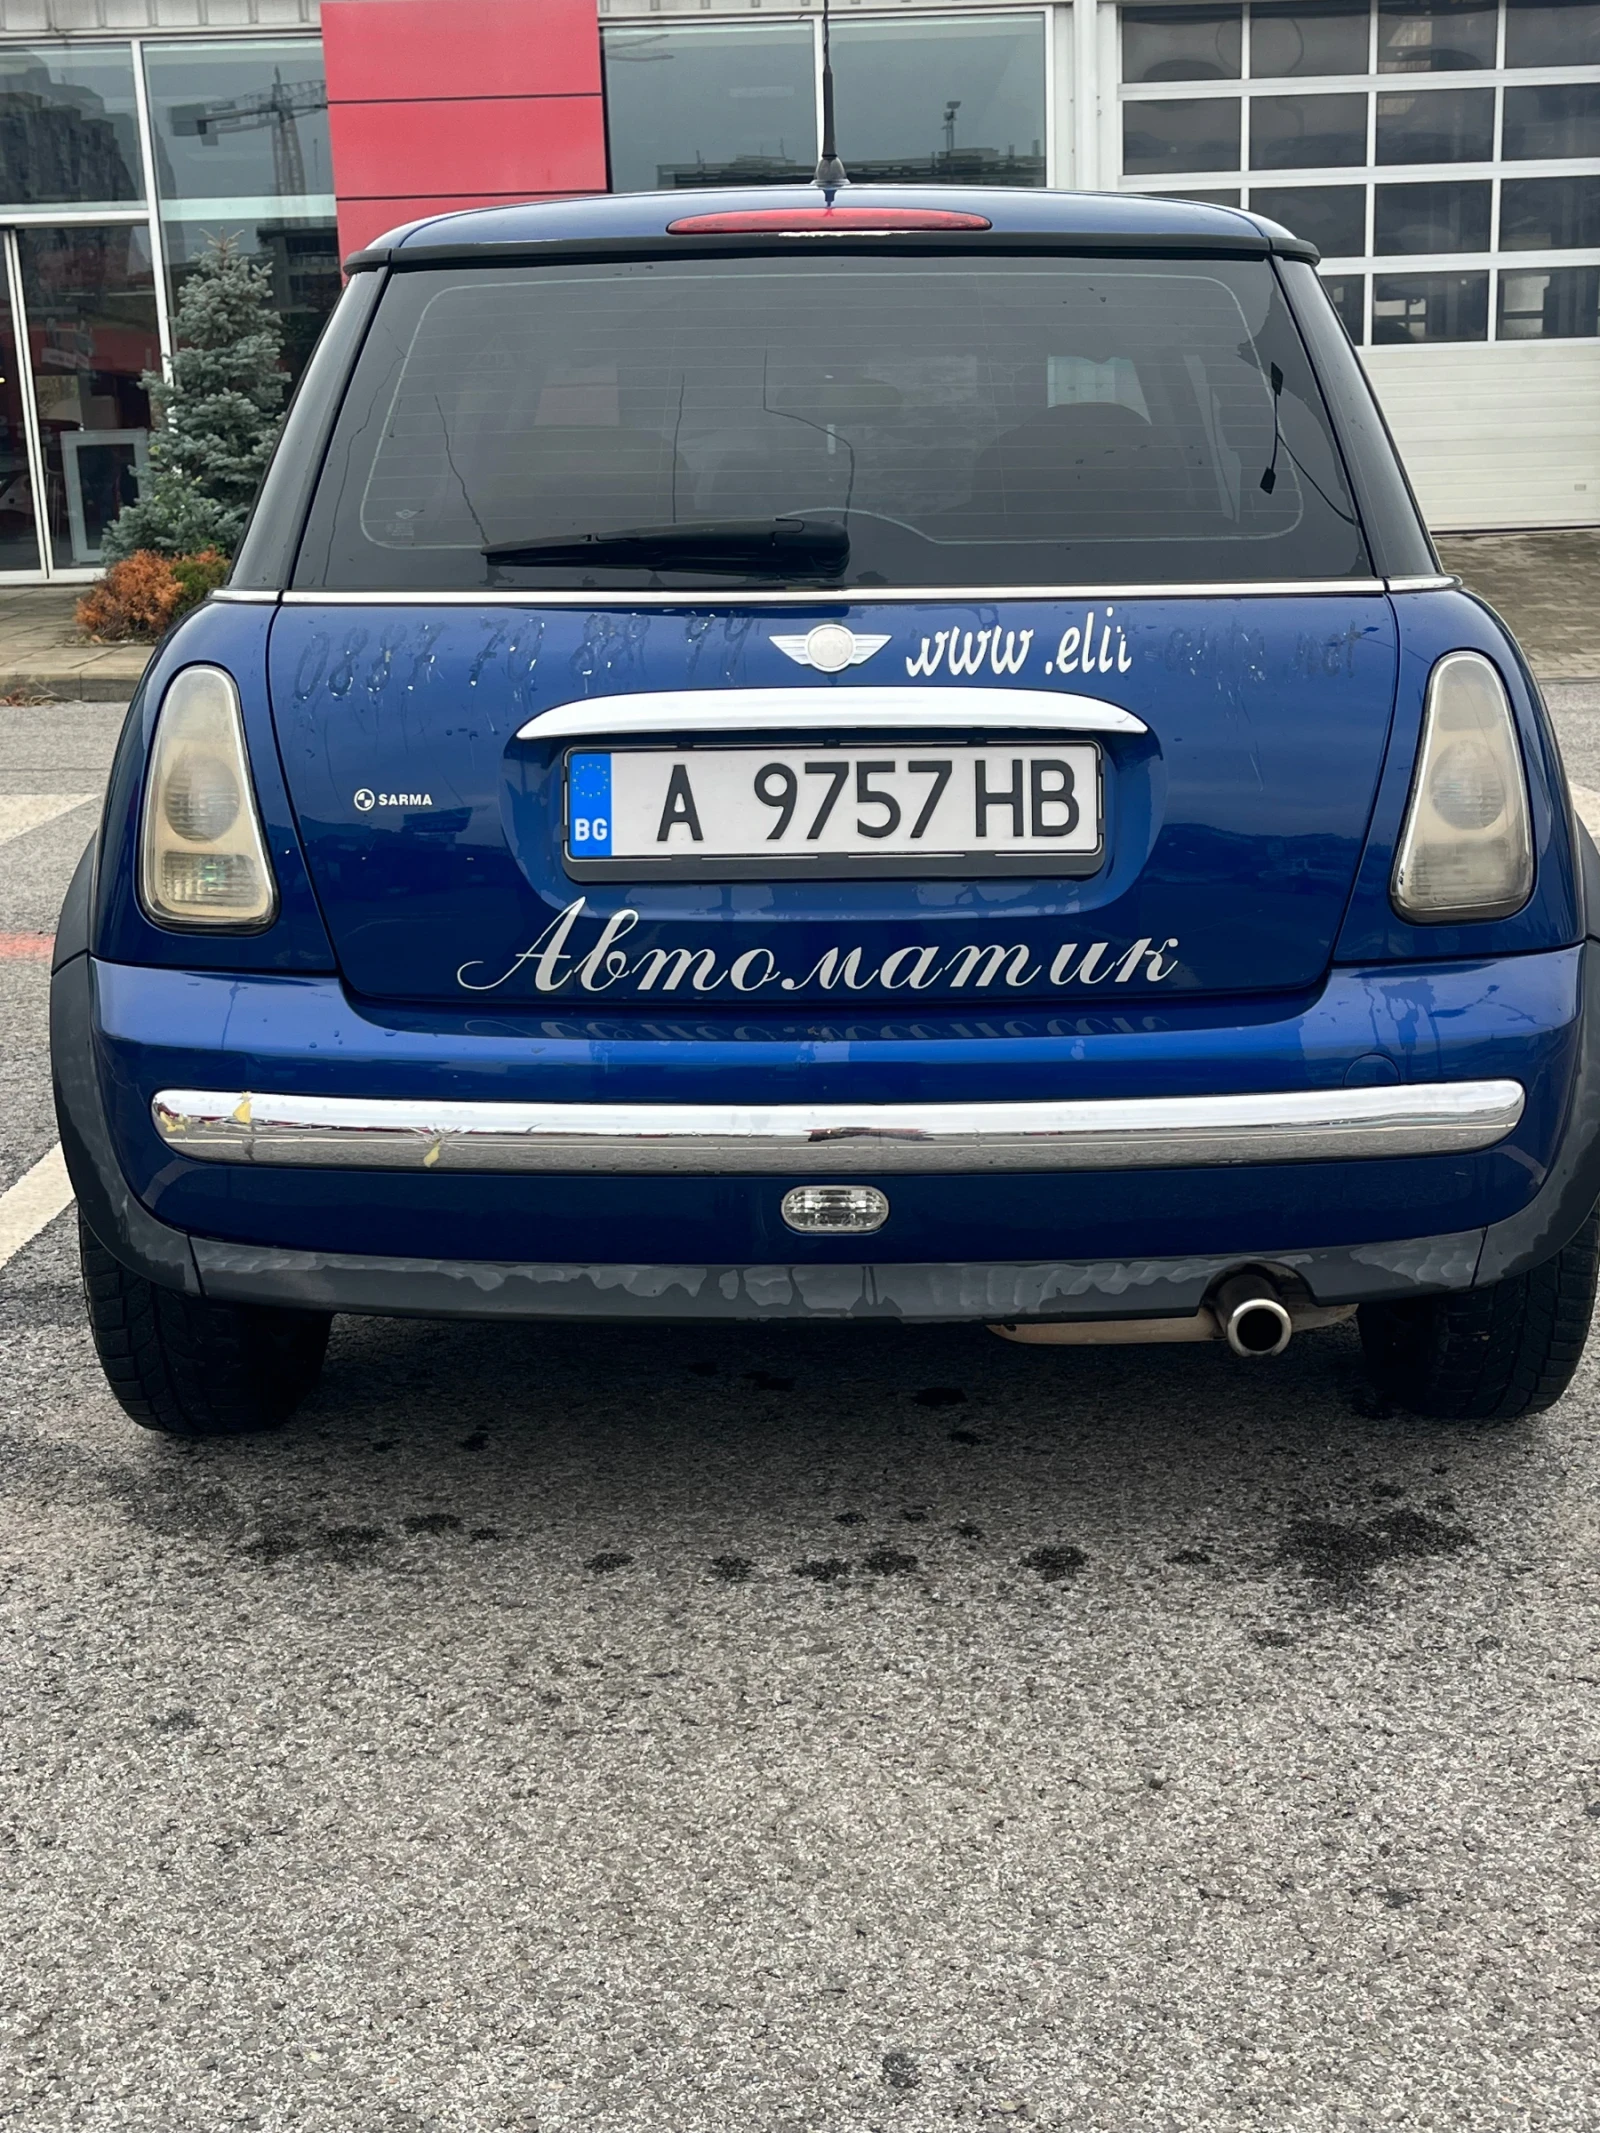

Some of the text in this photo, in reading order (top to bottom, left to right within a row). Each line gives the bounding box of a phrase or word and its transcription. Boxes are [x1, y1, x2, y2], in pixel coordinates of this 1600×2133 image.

[378, 793, 433, 806] SARMA
[753, 759, 953, 840] 9757
[574, 818, 608, 841] BG
[456, 896, 1179, 991] Автоматик
